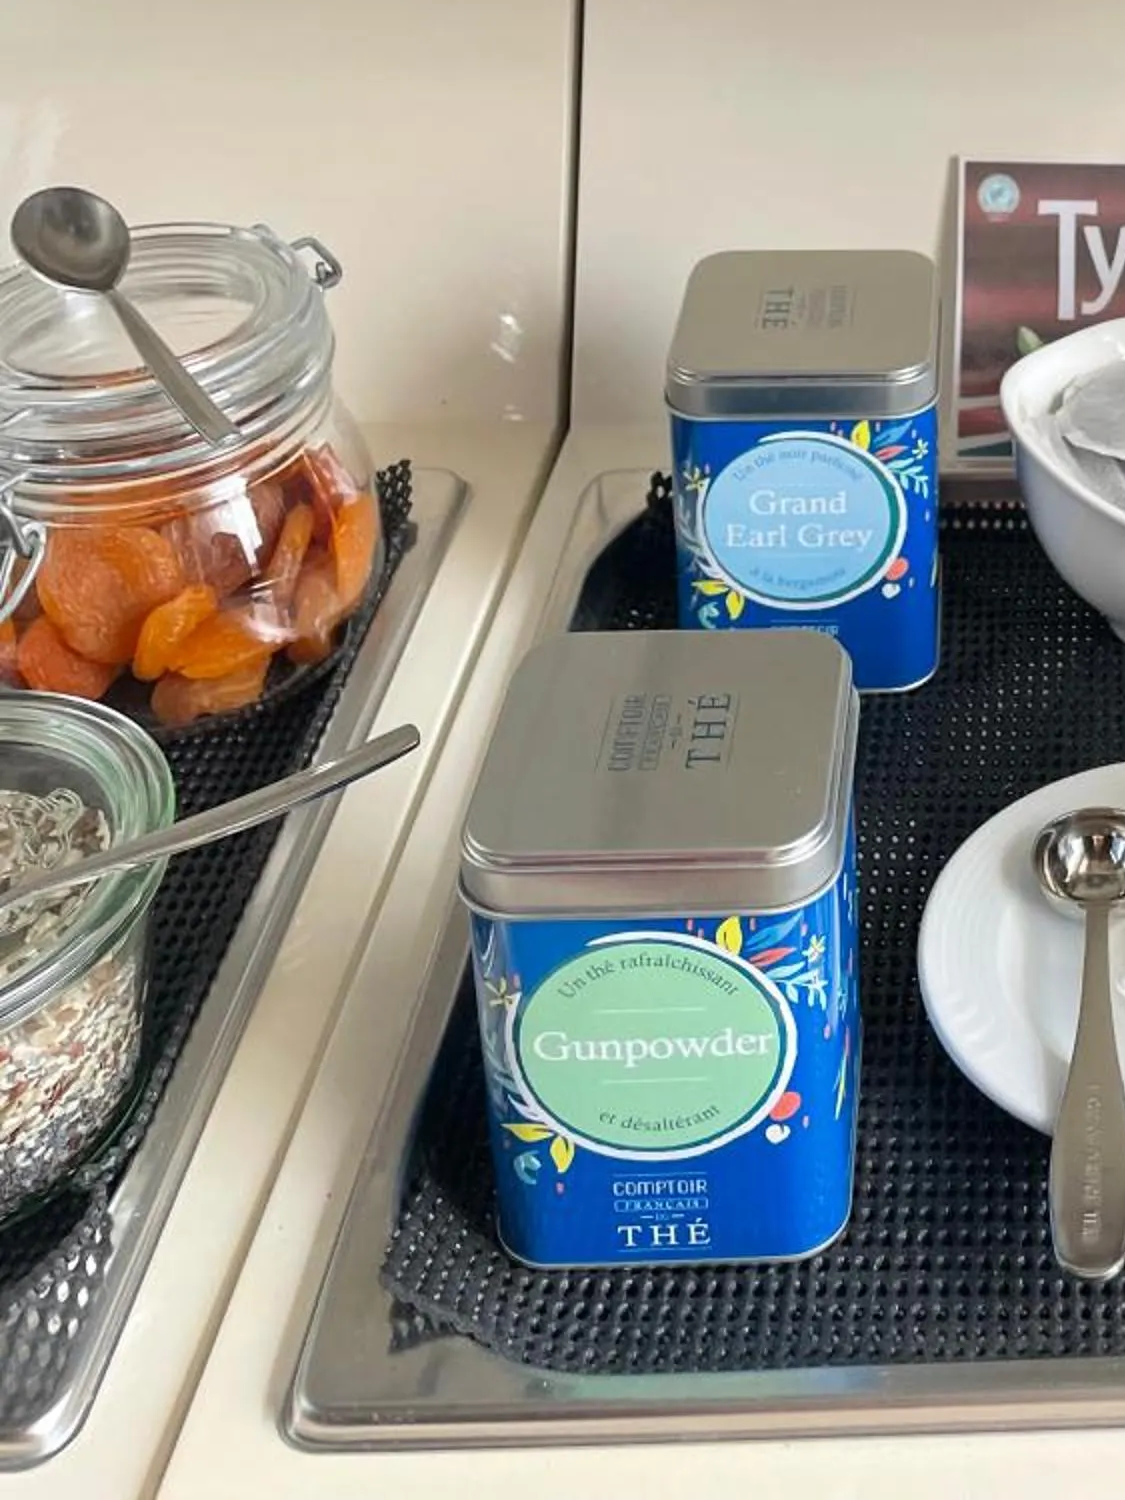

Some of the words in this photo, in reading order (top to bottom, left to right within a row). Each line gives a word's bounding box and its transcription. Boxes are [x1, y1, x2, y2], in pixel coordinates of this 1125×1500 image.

[749, 488, 850, 516] Grand
[725, 522, 787, 549] Earl
[797, 523, 873, 554] Grey
[684, 693, 732, 769] THÉ
[558, 974, 588, 999] Un
[587, 958, 617, 982] thé
[533, 1026, 773, 1068] Gunpowder
[601, 1110, 617, 1126] et
[619, 1104, 722, 1133] désaltérant
[613, 1178, 708, 1197] COMPTOIR
[617, 1217, 711, 1247] THÉ
